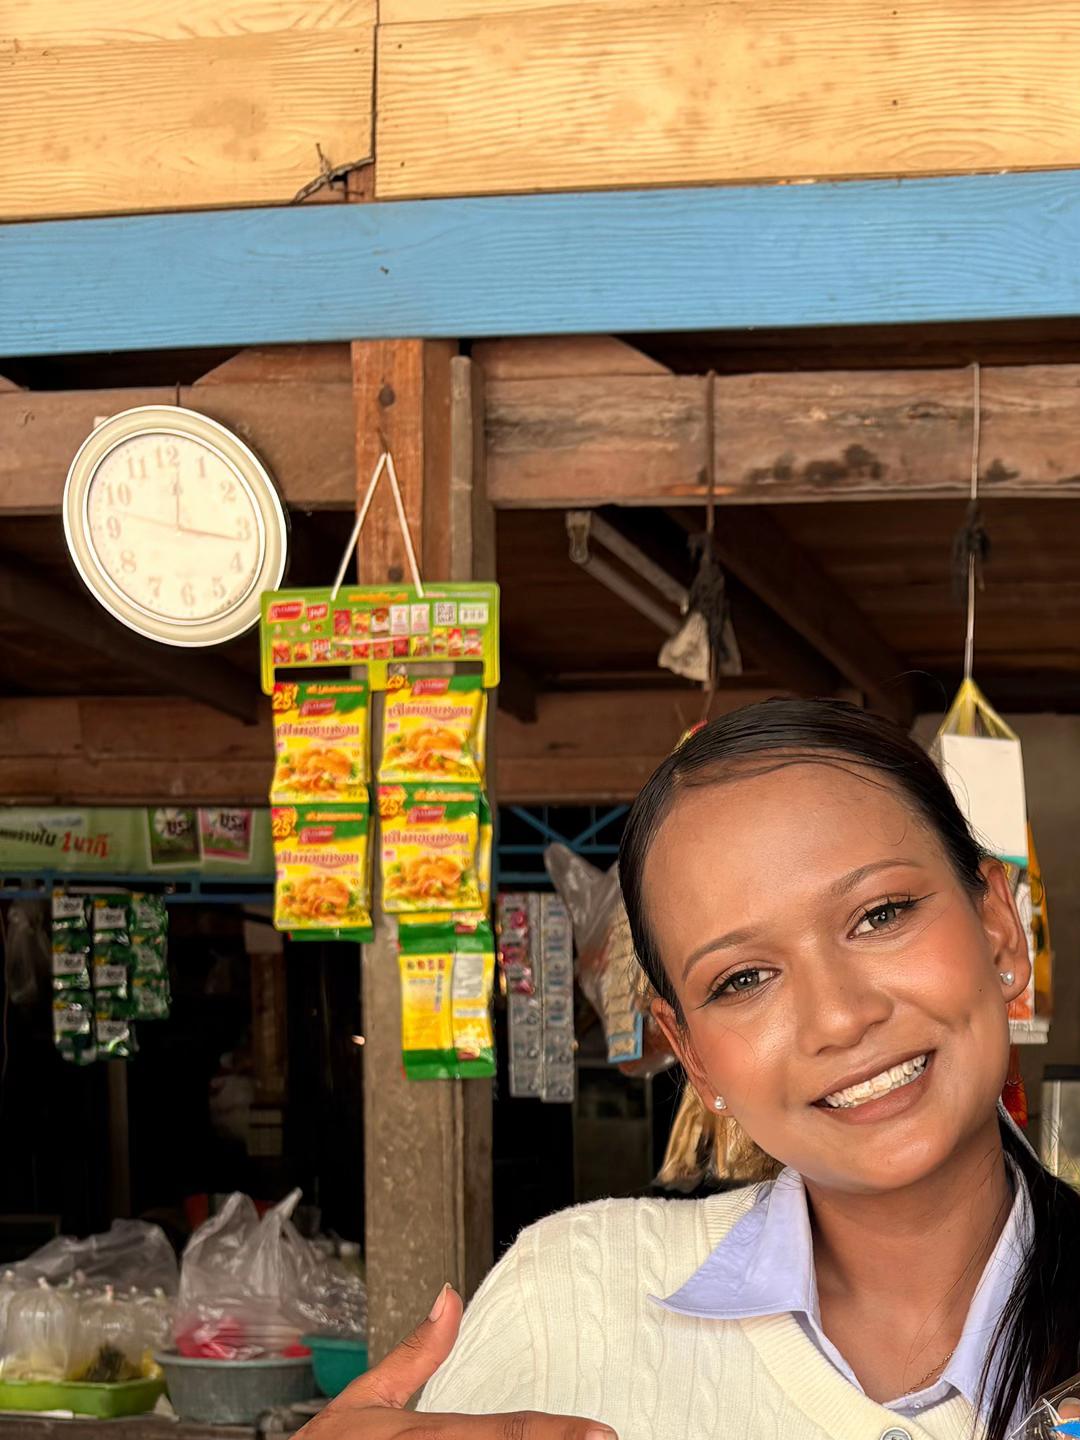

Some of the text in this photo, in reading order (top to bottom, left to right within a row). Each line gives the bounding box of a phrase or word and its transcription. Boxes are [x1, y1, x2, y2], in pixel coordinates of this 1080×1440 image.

[127, 456, 147, 479] 11
[154, 446, 181, 468] 12
[195, 456, 206, 478] 1
[107, 483, 132, 505] 10
[221, 481, 236, 503] 2
[107, 516, 121, 539] 9
[120, 550, 136, 573] 8
[230, 552, 243, 573] 4
[149, 576, 162, 598] 7
[180, 581, 196, 606] 6
[212, 576, 226, 598] 5
